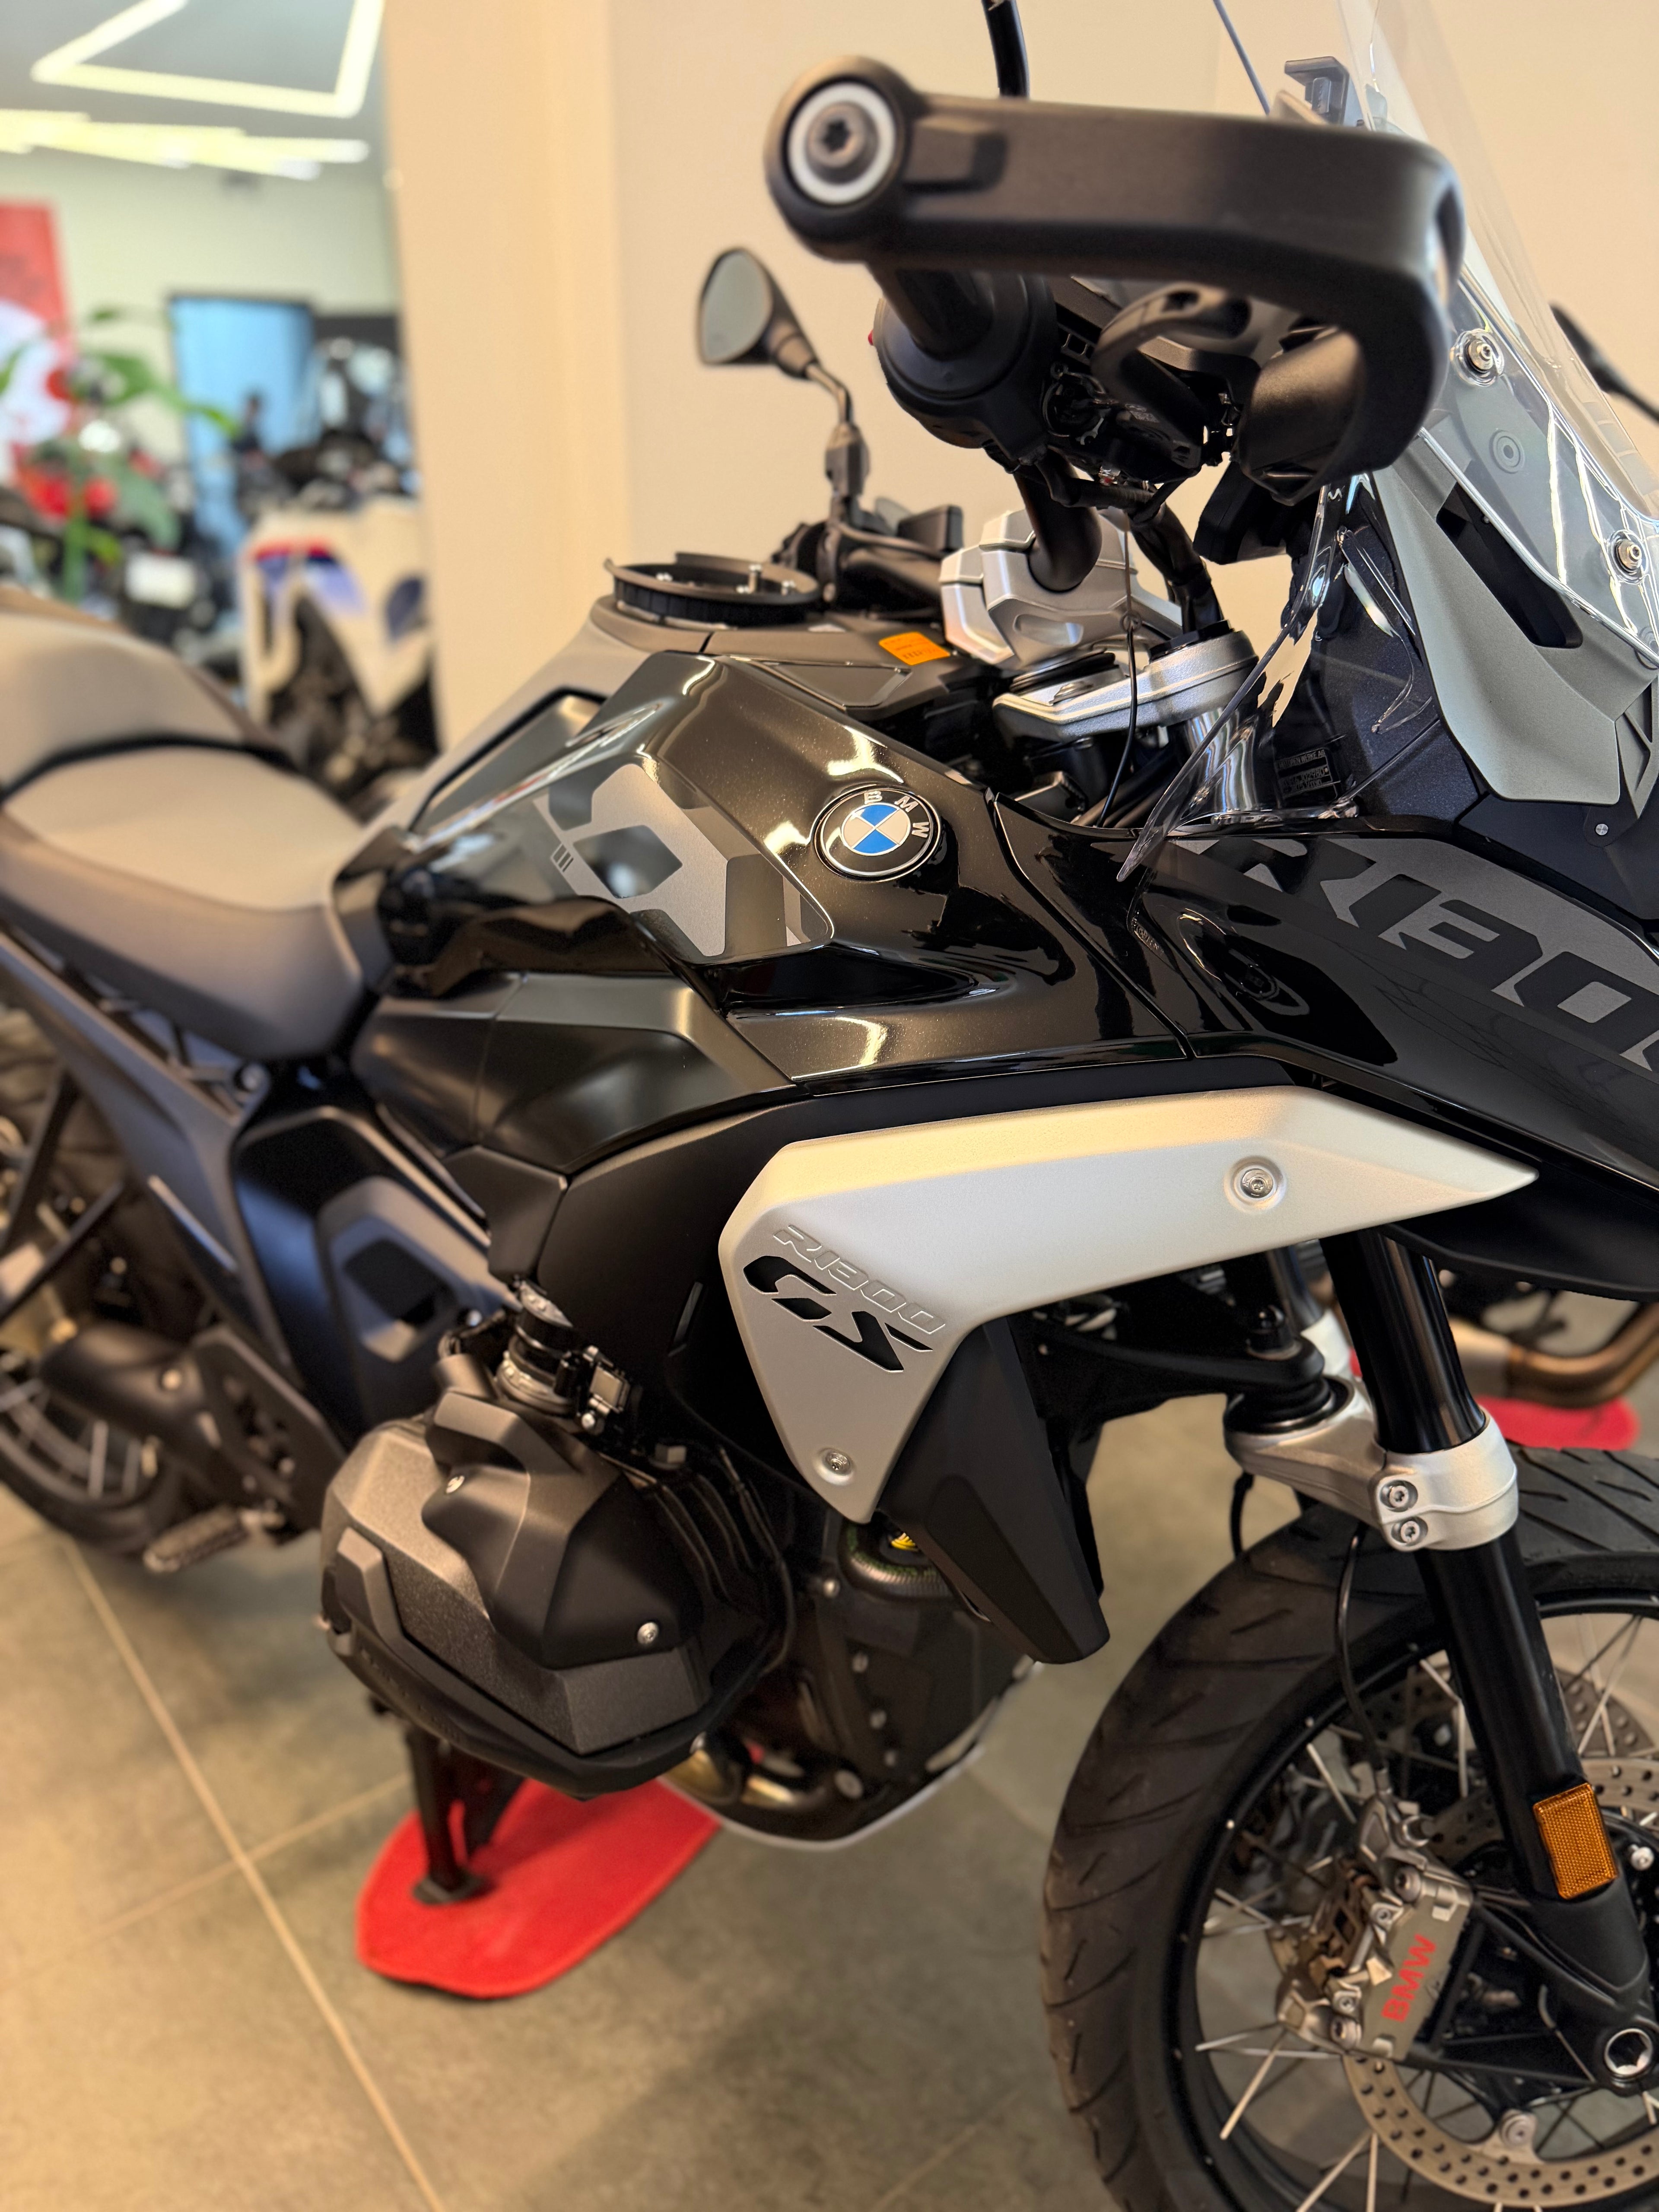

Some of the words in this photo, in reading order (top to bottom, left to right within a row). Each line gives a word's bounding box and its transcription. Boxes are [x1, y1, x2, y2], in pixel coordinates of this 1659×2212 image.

[864, 790, 929, 838] BMW
[743, 1255, 933, 1373] GS
[1381, 1933, 1436, 2023] BMW
